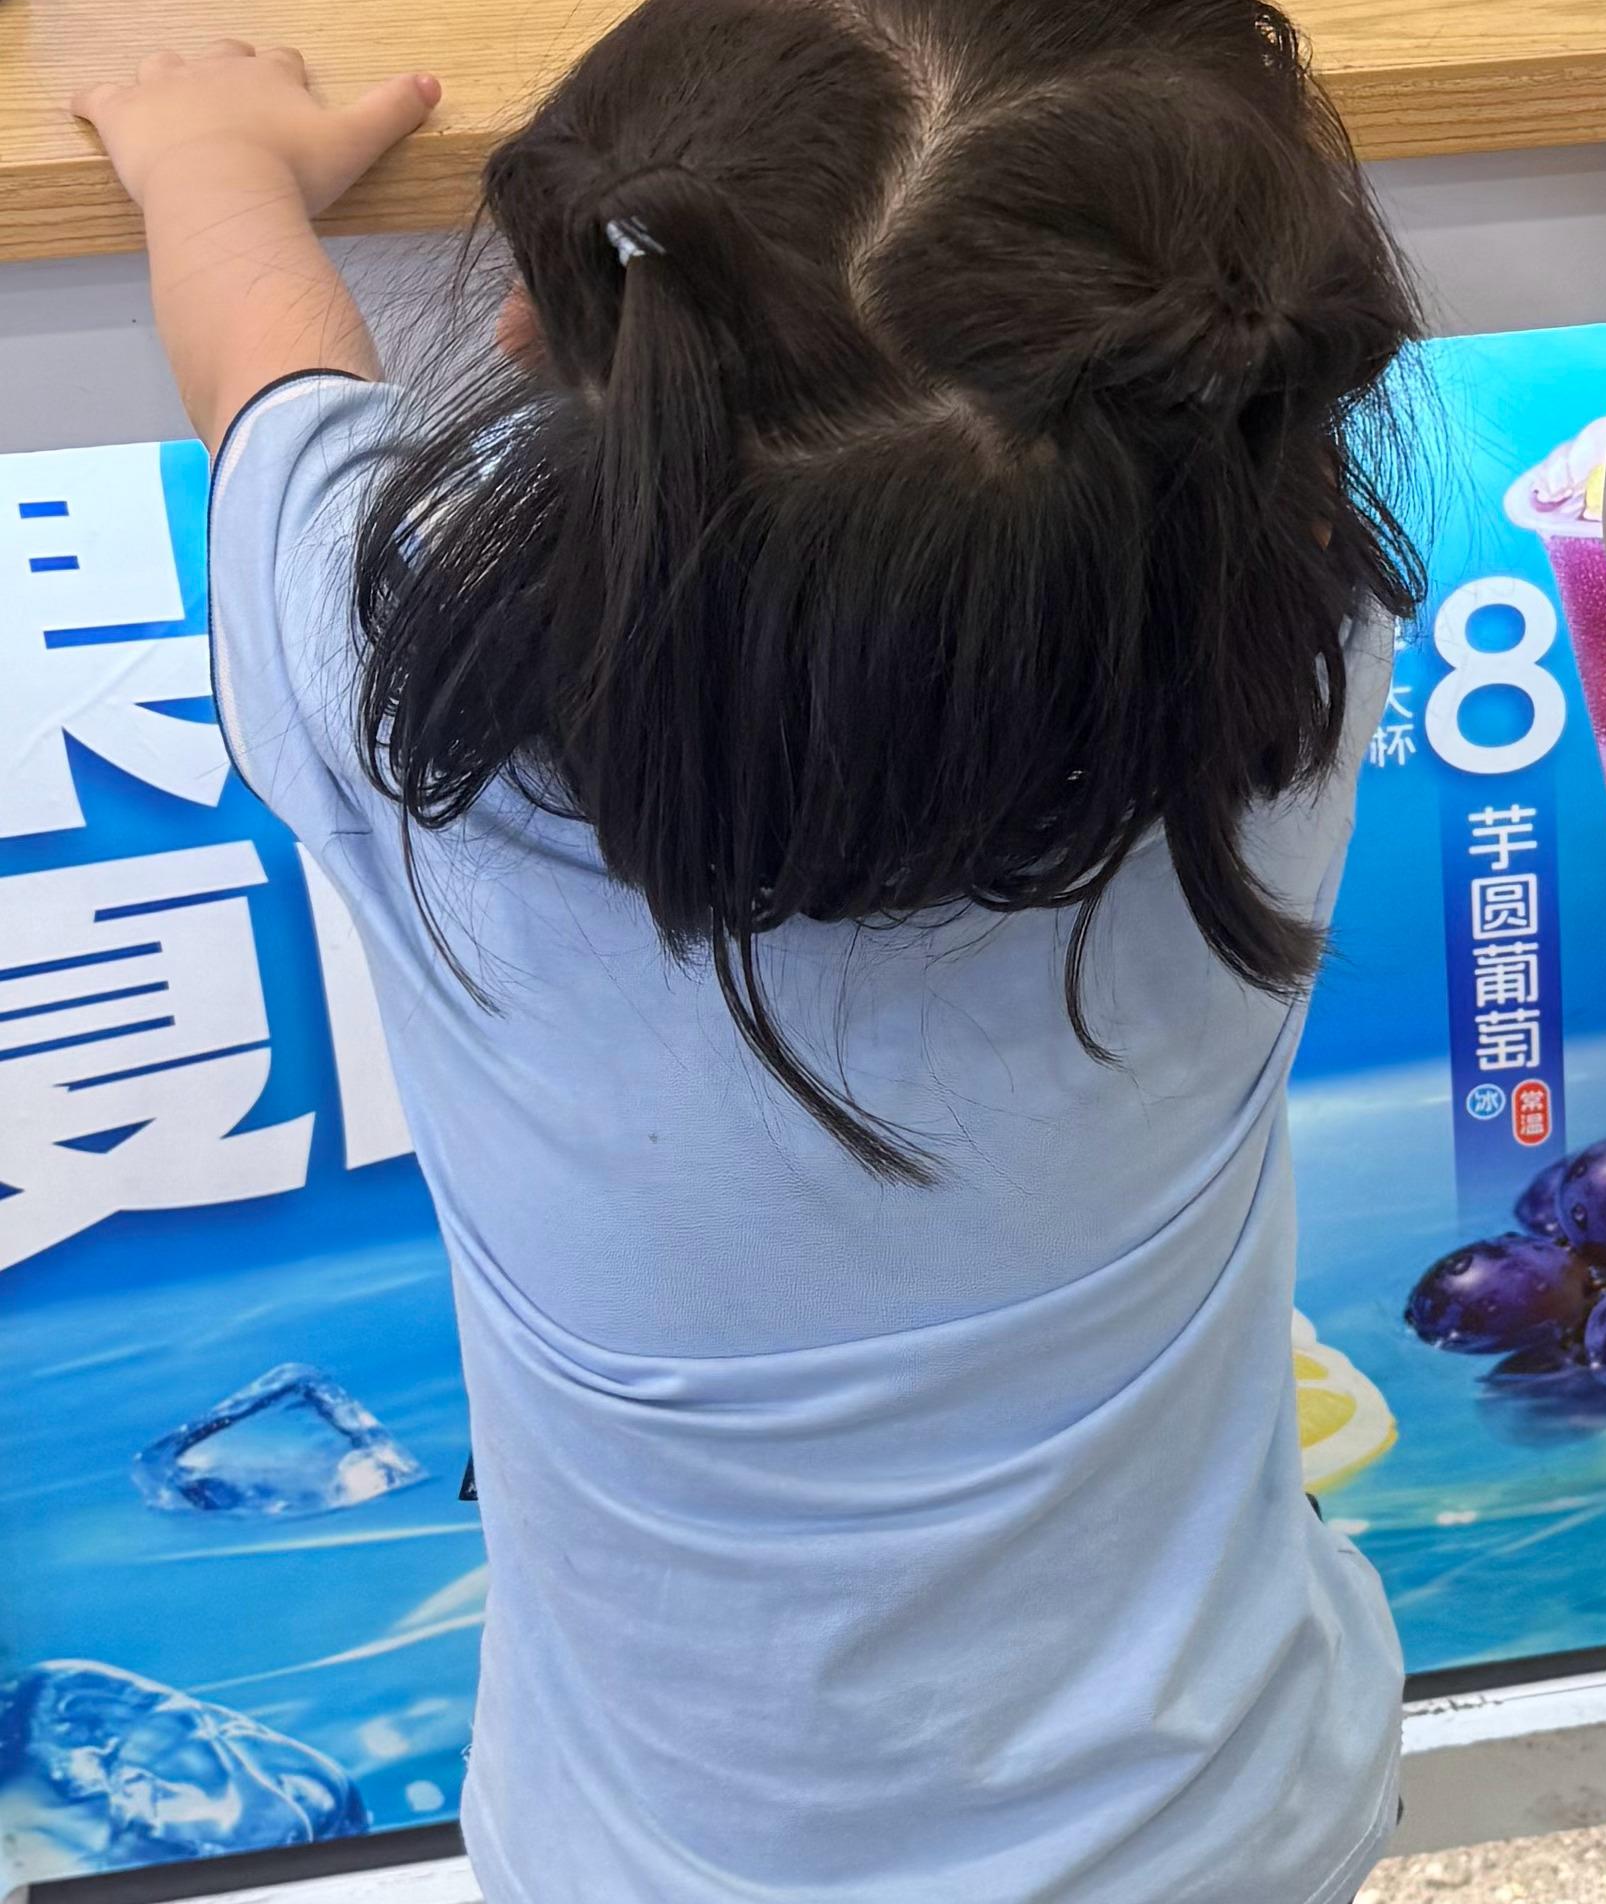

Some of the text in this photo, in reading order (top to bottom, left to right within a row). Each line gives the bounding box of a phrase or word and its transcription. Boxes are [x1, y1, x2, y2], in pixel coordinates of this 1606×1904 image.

[1468, 804, 1540, 1071] 芋圆葡萄
[1474, 1091, 1499, 1113] 冰
[1520, 1090, 1545, 1136] 常温
